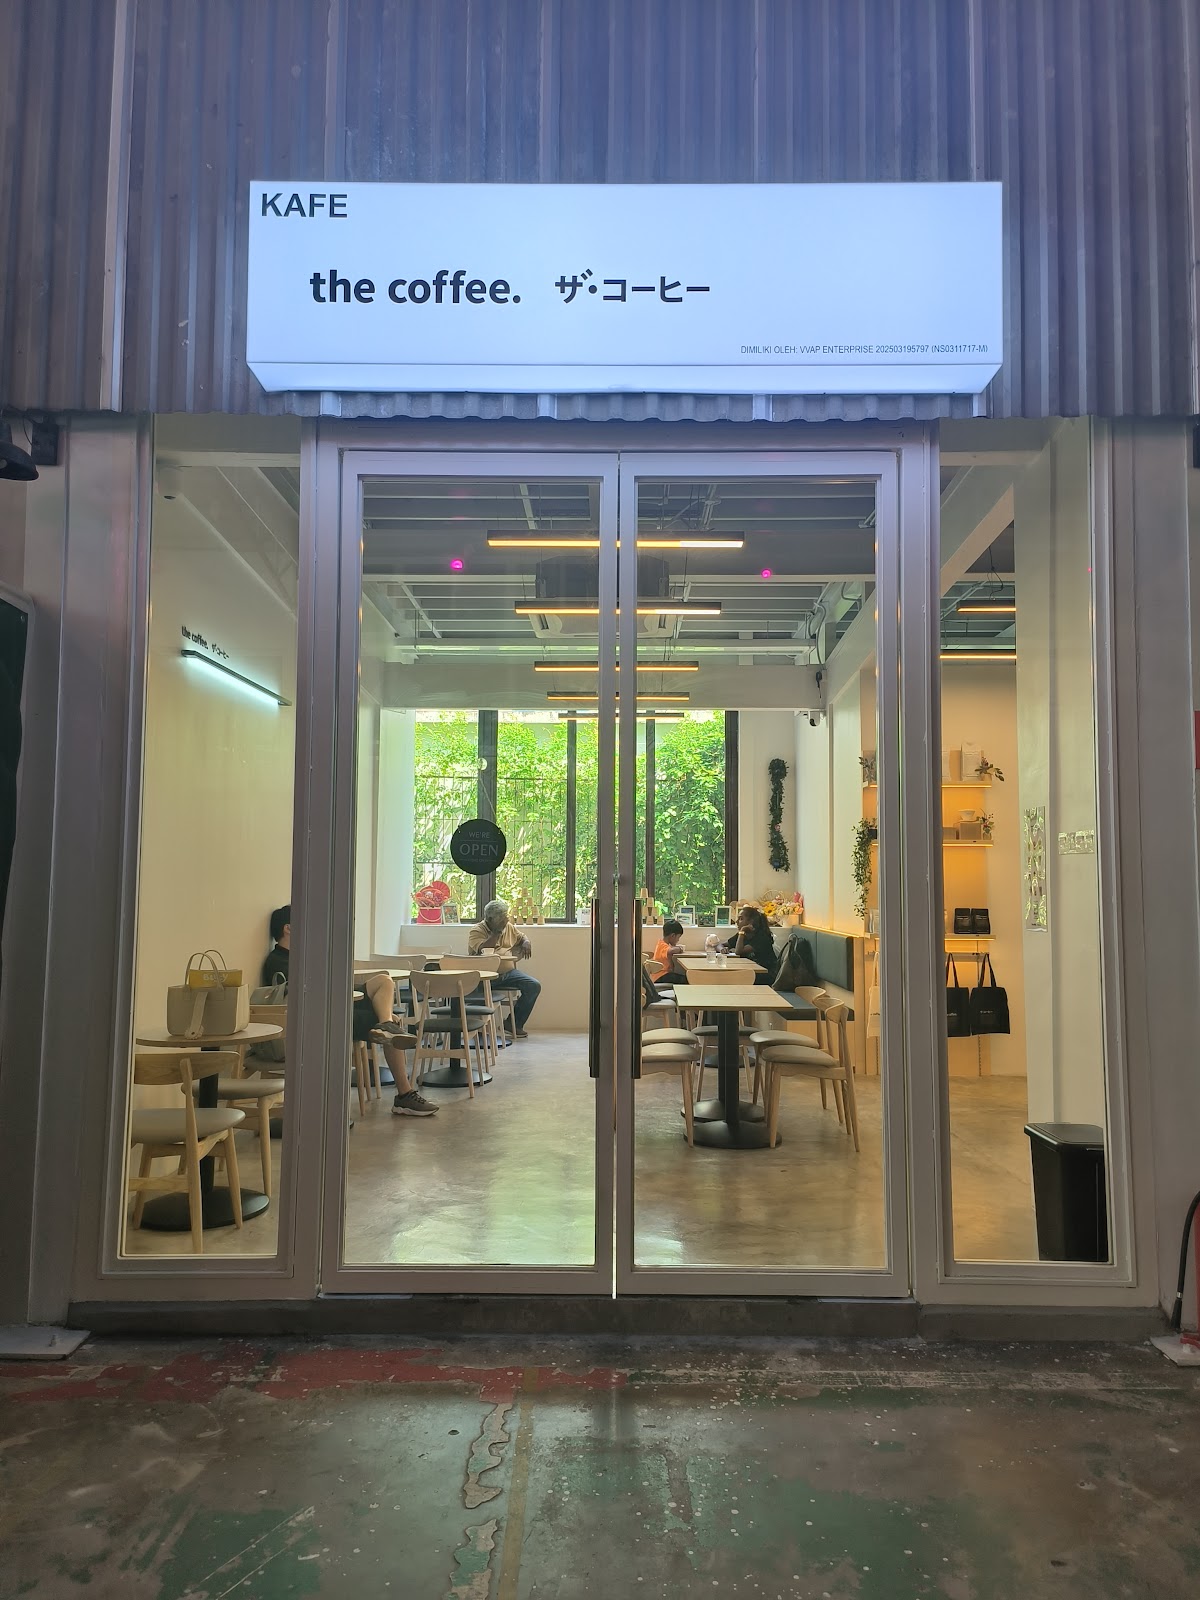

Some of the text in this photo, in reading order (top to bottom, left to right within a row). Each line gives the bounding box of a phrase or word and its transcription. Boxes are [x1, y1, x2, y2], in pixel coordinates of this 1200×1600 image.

[261, 192, 348, 218] KAFE
[309, 269, 522, 305] the coffee.
[554, 268, 711, 304] ザ・コーヒー
[740, 345, 772, 354] DIMILIKI
[773, 345, 798, 354] OLEH:
[822, 345, 874, 354] ENTERPRISE
[875, 344, 930, 354] 202503195797
[931, 344, 989, 354] (NS0311717-M)
[181, 626, 191, 639] the
[468, 831, 490, 839] WE'RE
[459, 843, 499, 856] OPEN
